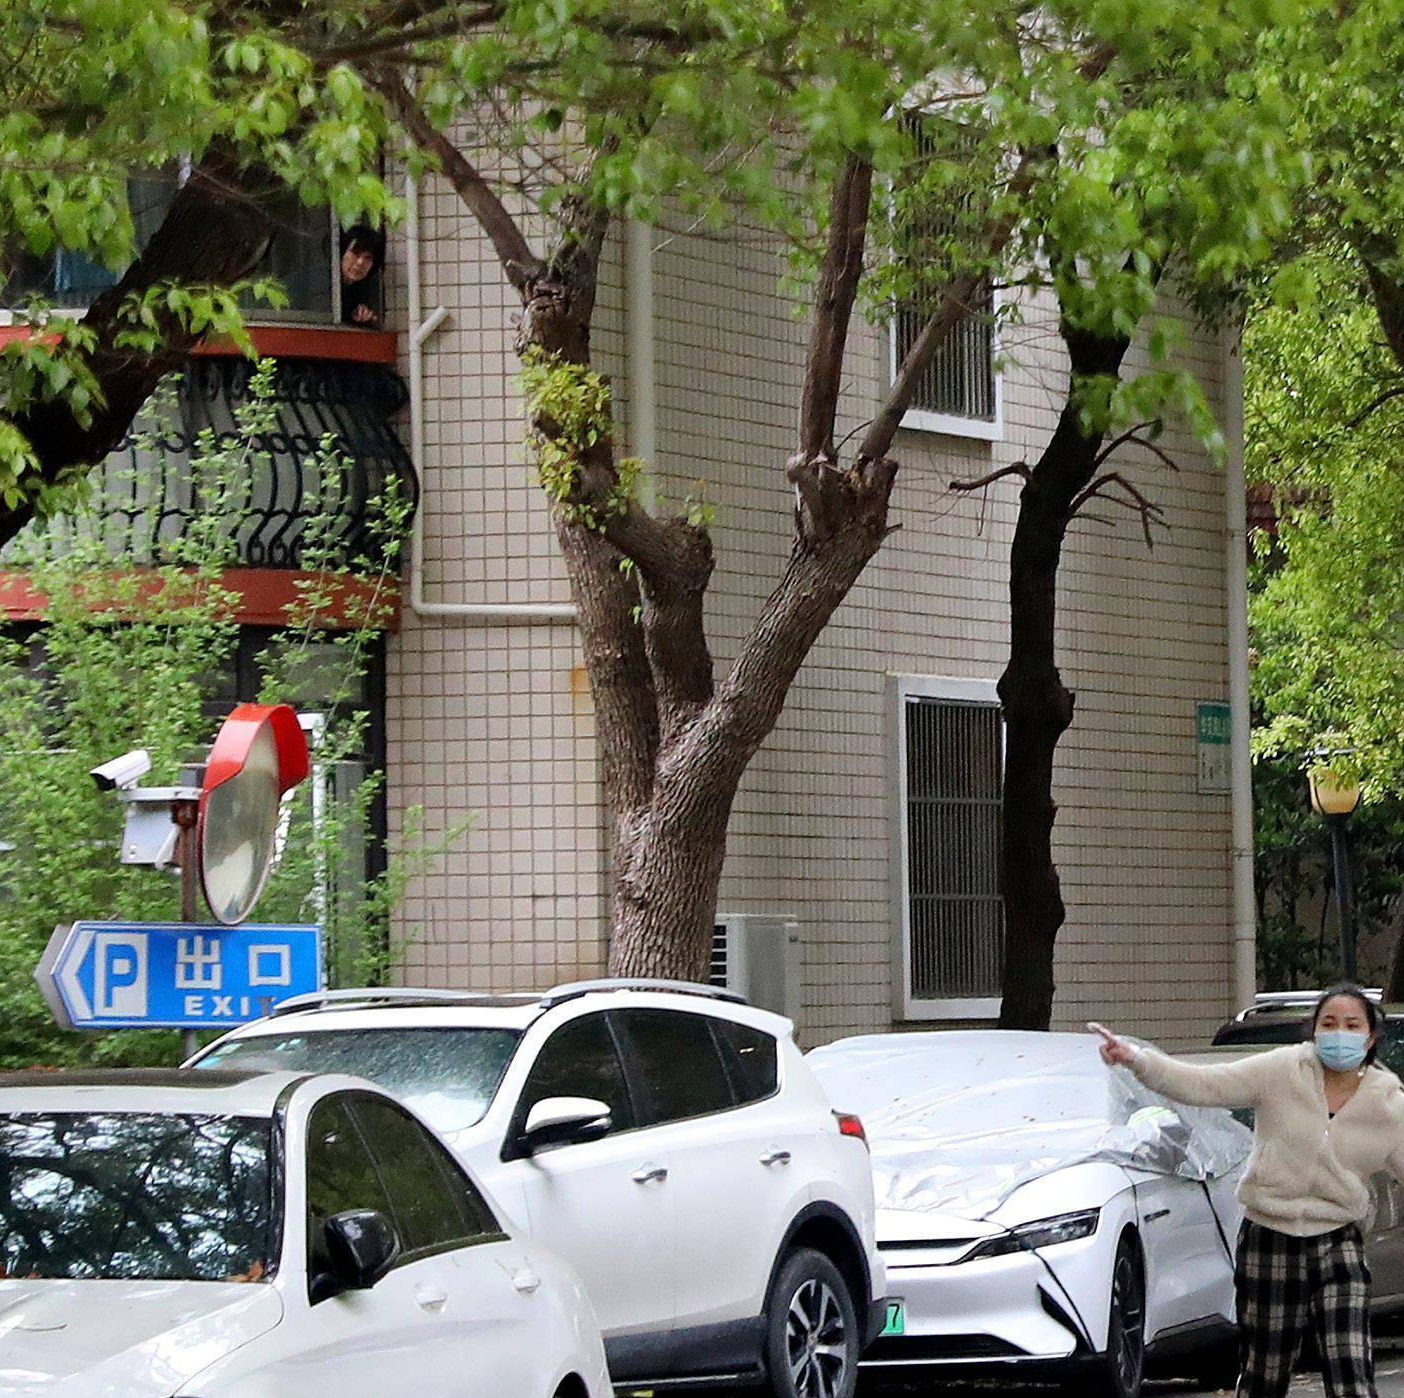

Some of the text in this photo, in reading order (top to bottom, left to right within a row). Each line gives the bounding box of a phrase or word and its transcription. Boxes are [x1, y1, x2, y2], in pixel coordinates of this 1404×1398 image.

[104, 943, 138, 1007] P
[175, 935, 291, 989] 出口
[185, 994, 277, 1017] EXIT
